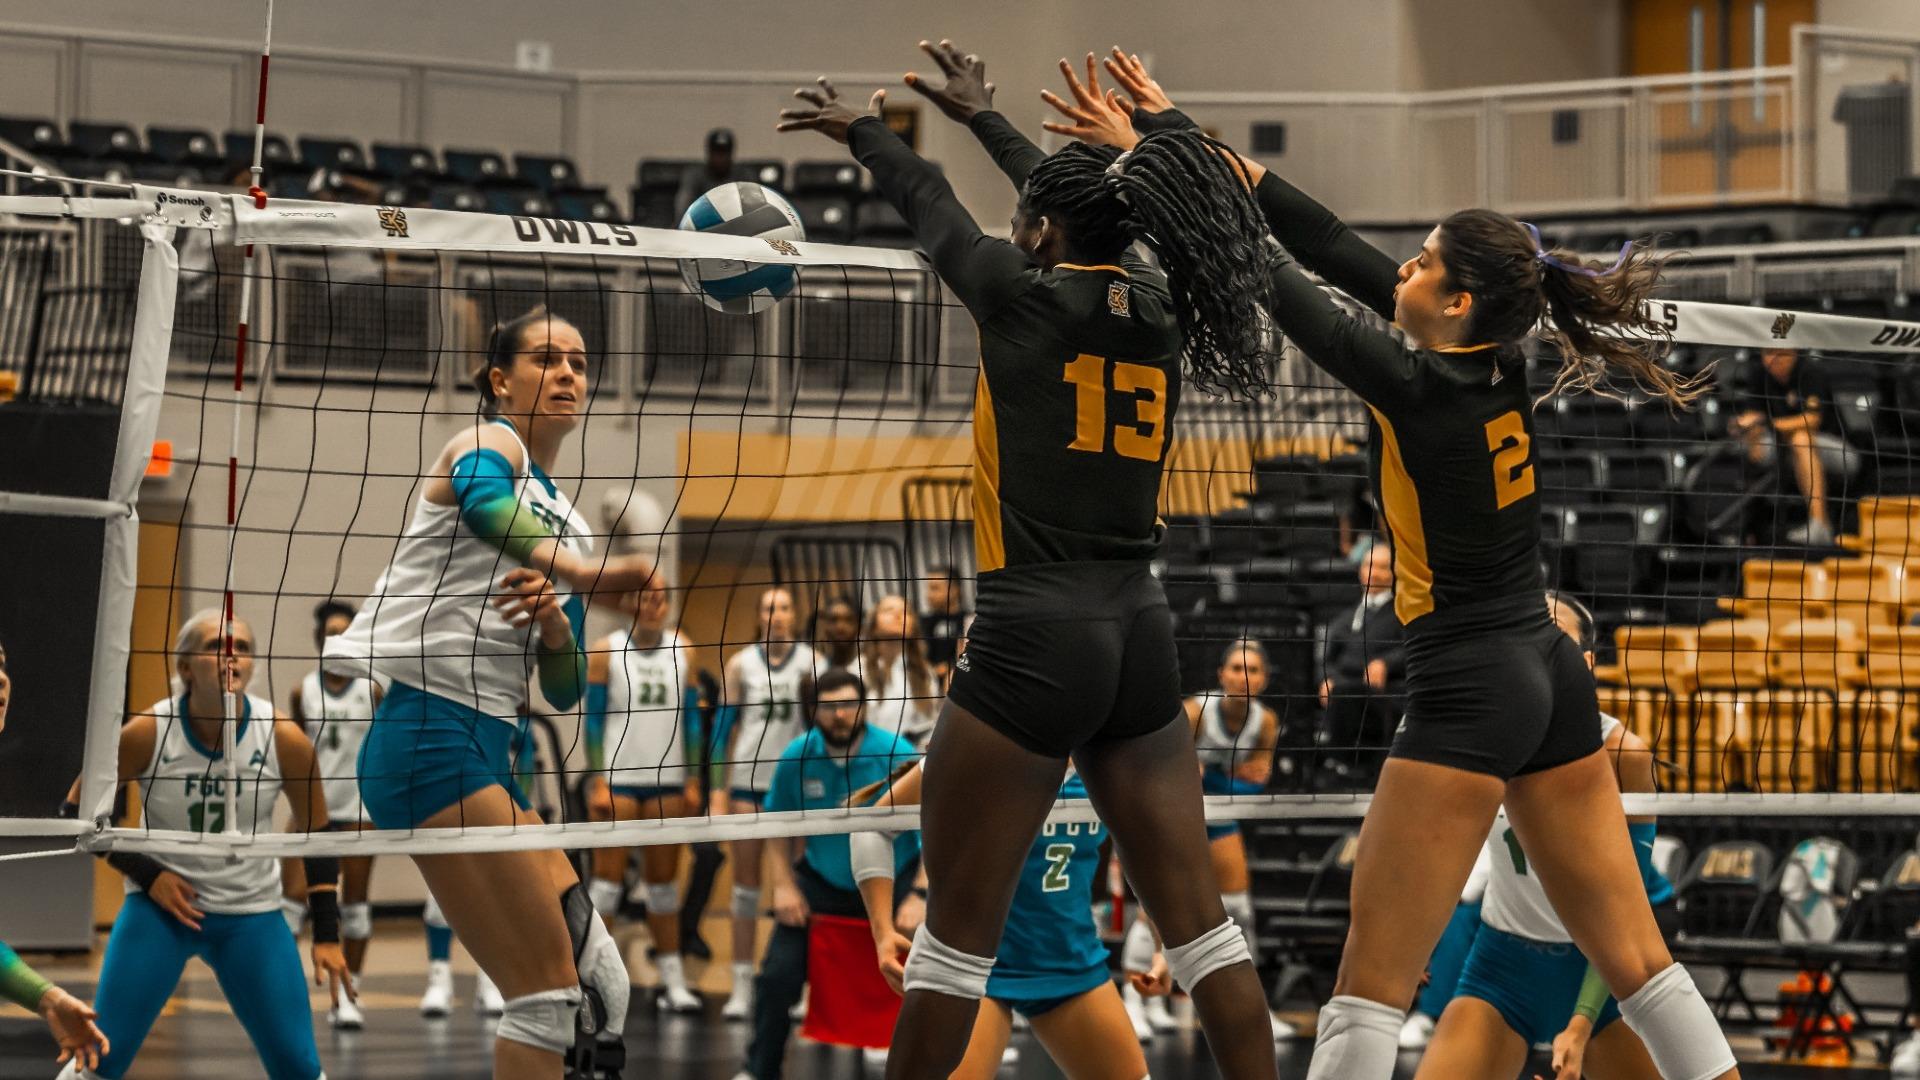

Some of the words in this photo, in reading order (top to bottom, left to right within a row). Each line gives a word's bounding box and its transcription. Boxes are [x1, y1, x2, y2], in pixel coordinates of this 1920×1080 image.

[168, 194, 205, 206] Senoh
[510, 215, 638, 247] OWLS
[1063, 352, 1167, 462] 13
[1484, 410, 1536, 511] 2
[1042, 843, 1076, 893] 2
